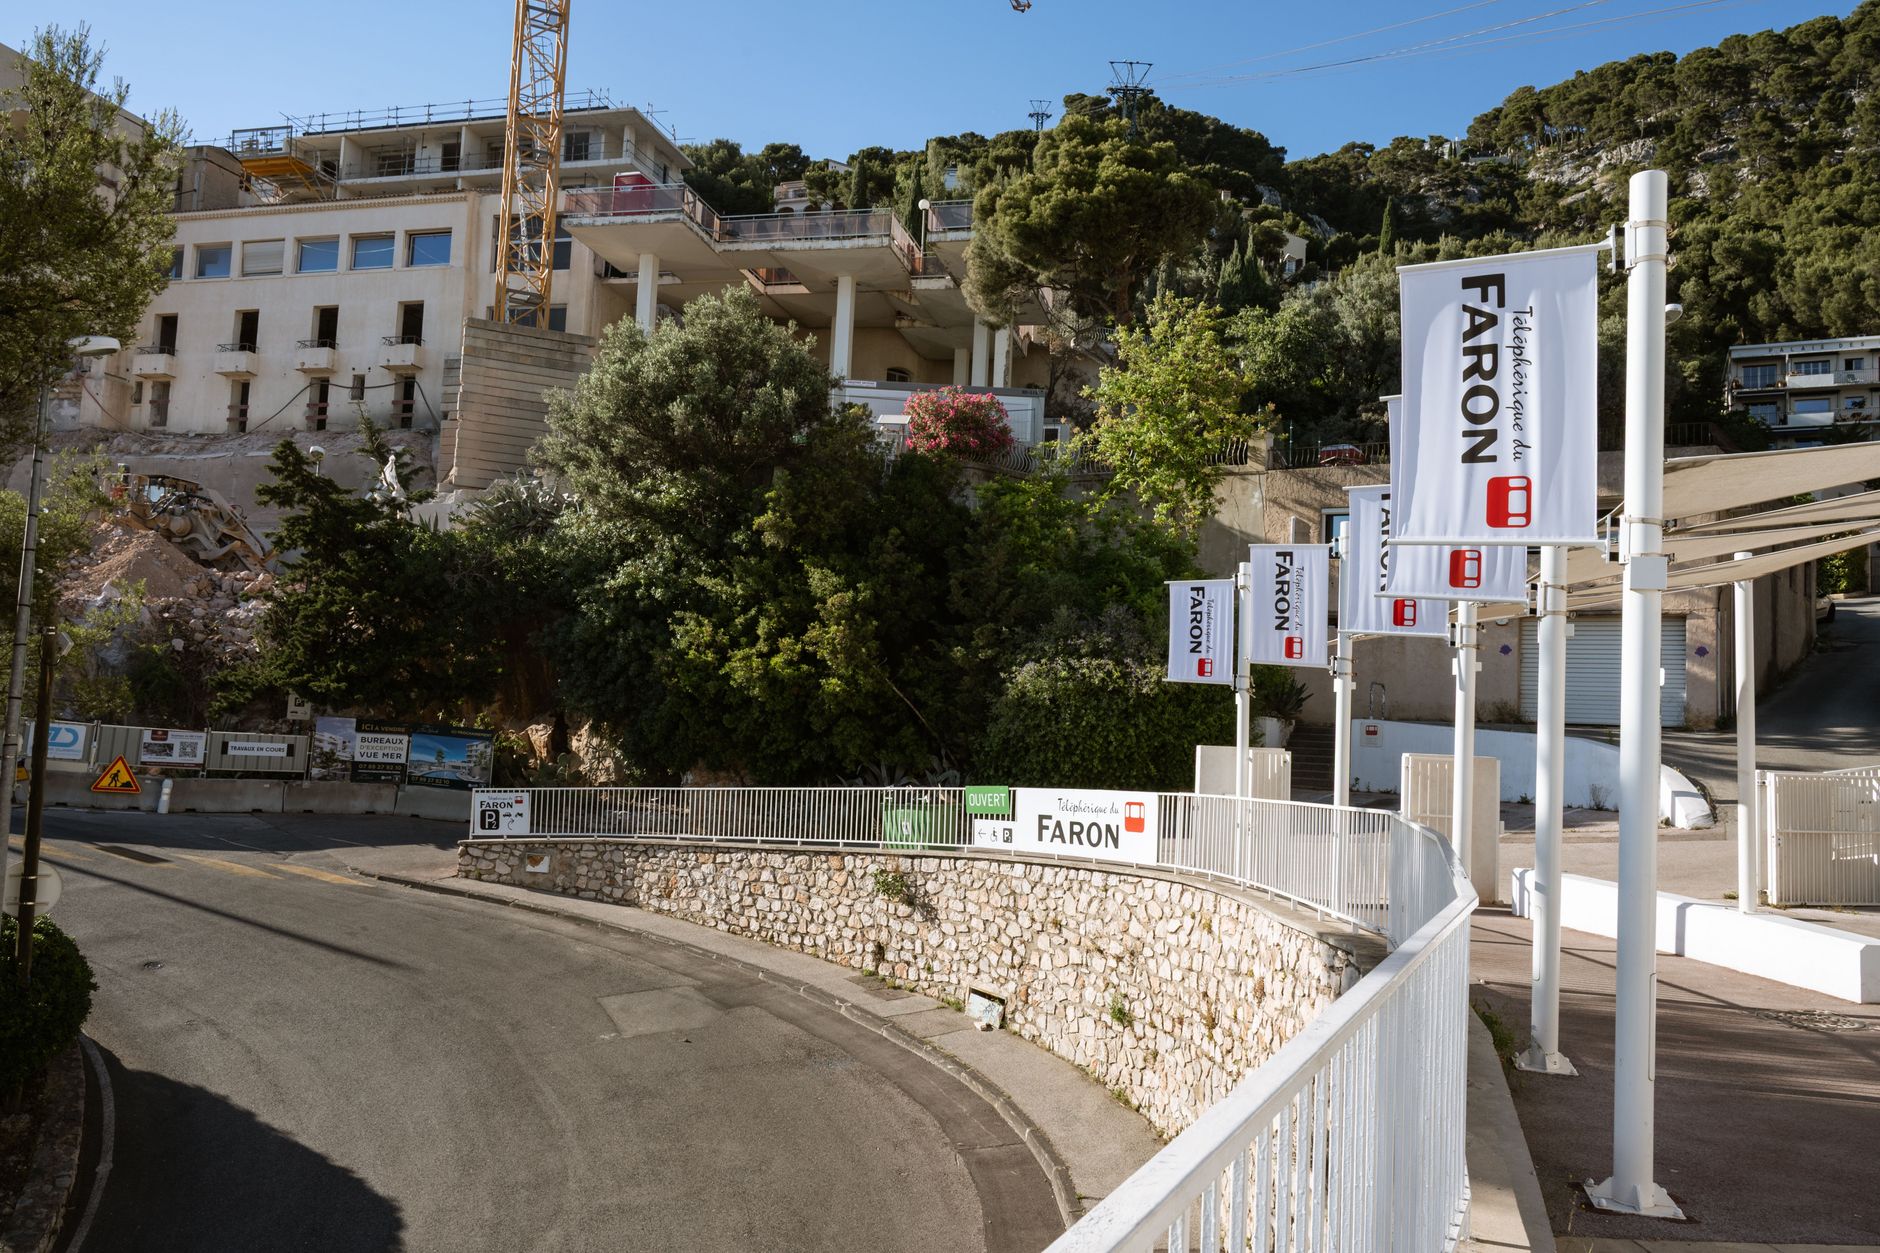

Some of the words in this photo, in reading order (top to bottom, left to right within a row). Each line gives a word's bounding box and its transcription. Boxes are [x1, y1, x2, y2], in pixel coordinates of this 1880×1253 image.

[1768, 343, 1824, 353] PALAIS
[1838, 341, 1864, 349] DES
[1461, 273, 1505, 463] FARON
[1505, 306, 1533, 432] Téléphérique
[1513, 439, 1531, 462] du
[1274, 551, 1293, 631] FARON
[1190, 586, 1205, 653] FARON
[360, 736, 404, 745] BUREAUX
[382, 752, 402, 760] MER
[480, 800, 513, 809] FARON
[969, 793, 1006, 807] OUVERT
[1058, 798, 1107, 817] Téléphérique
[1109, 802, 1119, 814] du
[485, 811, 497, 829] P2
[1037, 814, 1119, 849] FARON
